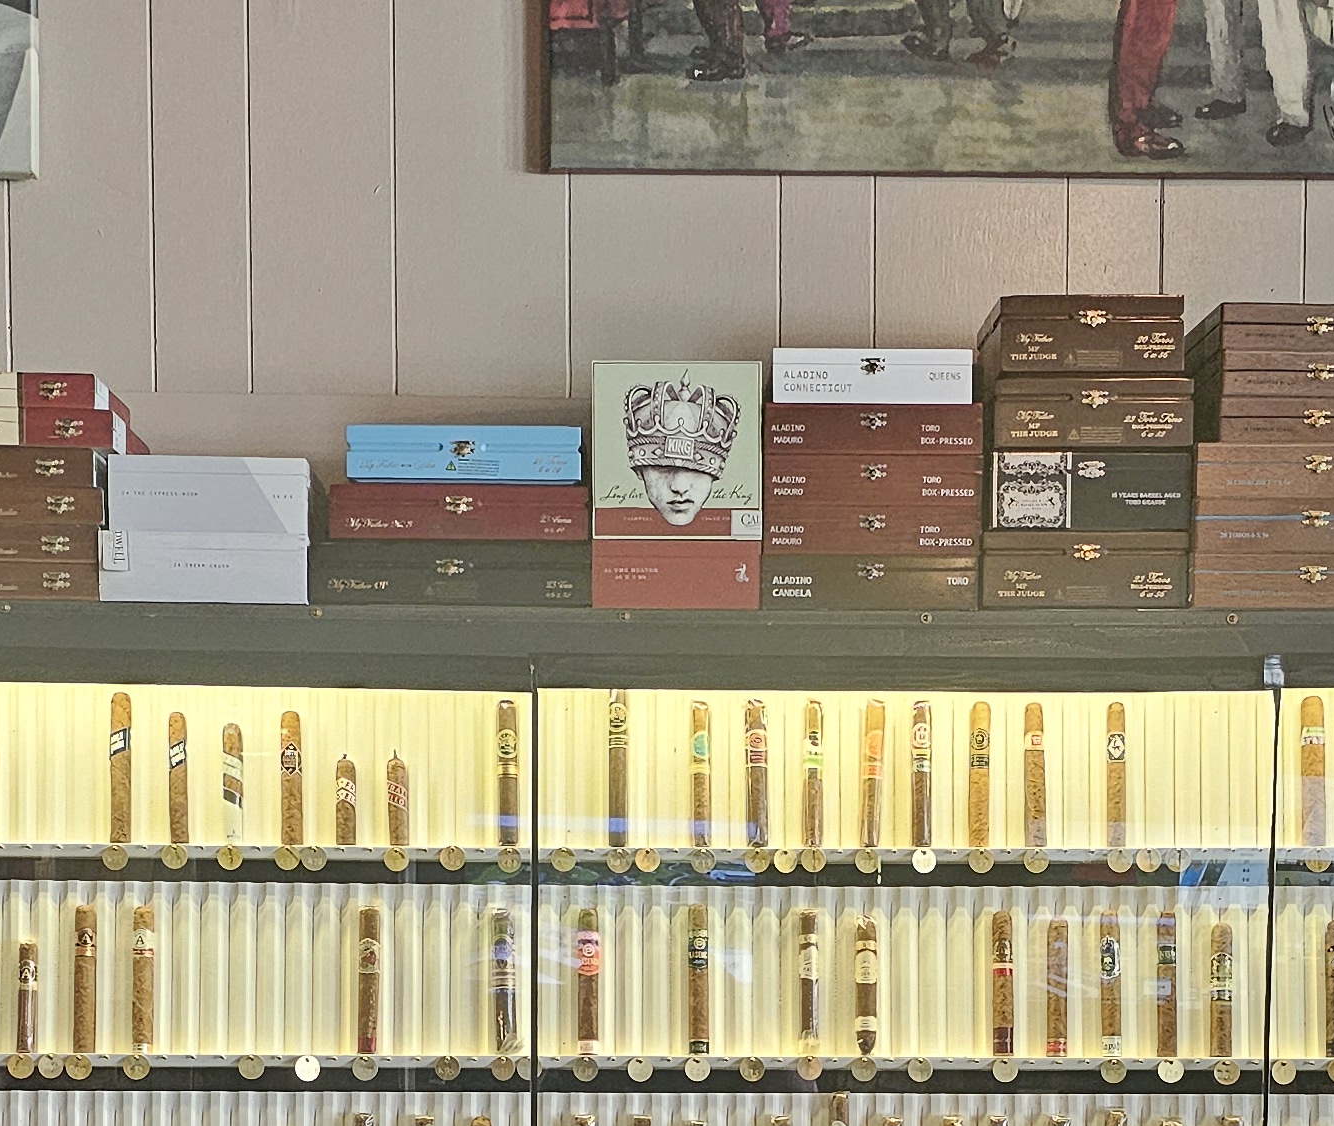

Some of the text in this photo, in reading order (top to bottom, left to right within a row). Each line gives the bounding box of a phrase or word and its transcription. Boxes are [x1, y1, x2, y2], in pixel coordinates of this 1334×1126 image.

[784, 371, 828, 379] ALADINO
[929, 372, 961, 381] QUEENS
[784, 384, 852, 392] CONNECTICUT
[771, 424, 805, 432] ALADINO
[774, 436, 803, 444] MADURO
[667, 440, 692, 455] KING
[772, 576, 812, 585] ALADINO
[947, 577, 969, 585] TORO
[772, 589, 812, 598] CANDELA
